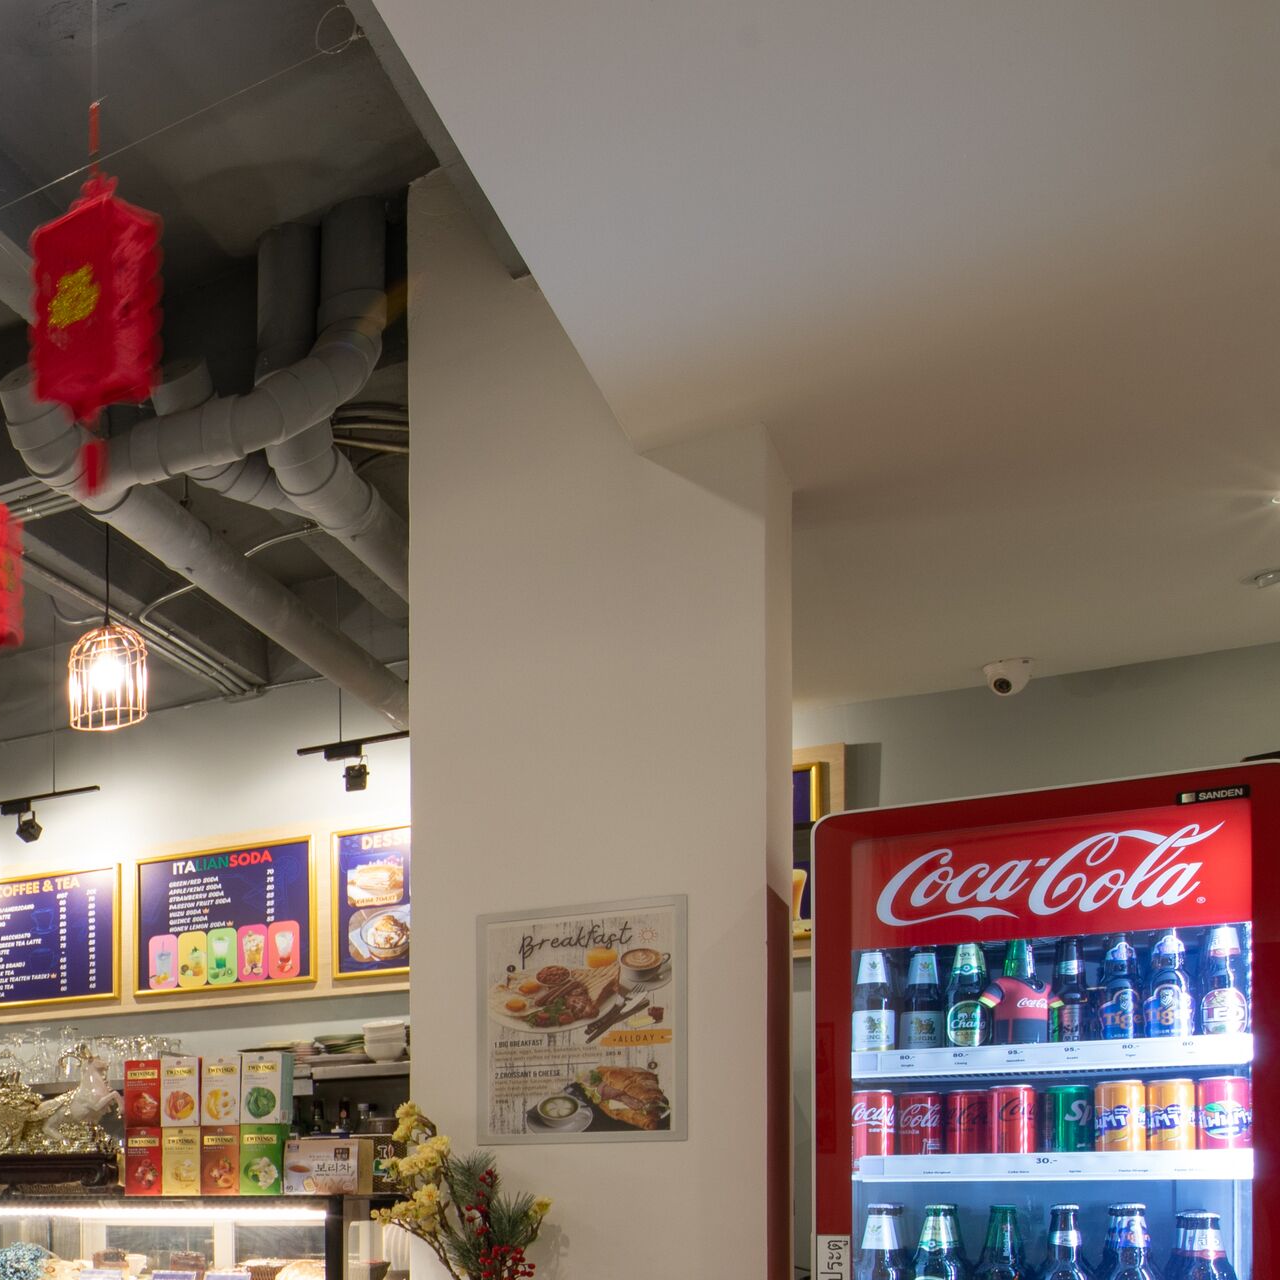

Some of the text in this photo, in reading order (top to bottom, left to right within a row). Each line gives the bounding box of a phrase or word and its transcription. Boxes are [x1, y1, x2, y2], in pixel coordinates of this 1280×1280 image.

[1198, 788, 1244, 801] SANDEN
[876, 820, 1226, 926] Coca-Cola
[42, 880, 53, 893] &
[56, 876, 81, 891] TEA
[215, 897, 231, 905] SODA
[192, 915, 208, 923] SODA
[210, 921, 226, 929] SODA
[26, 938, 42, 946] LATTE
[519, 921, 633, 969] Breakfast
[951, 1019, 986, 1029] Chang
[509, 1039, 543, 1048] BREAKFAST
[166, 1068, 192, 1076] TWININGS
[314, 1162, 352, 1173] 보리차
